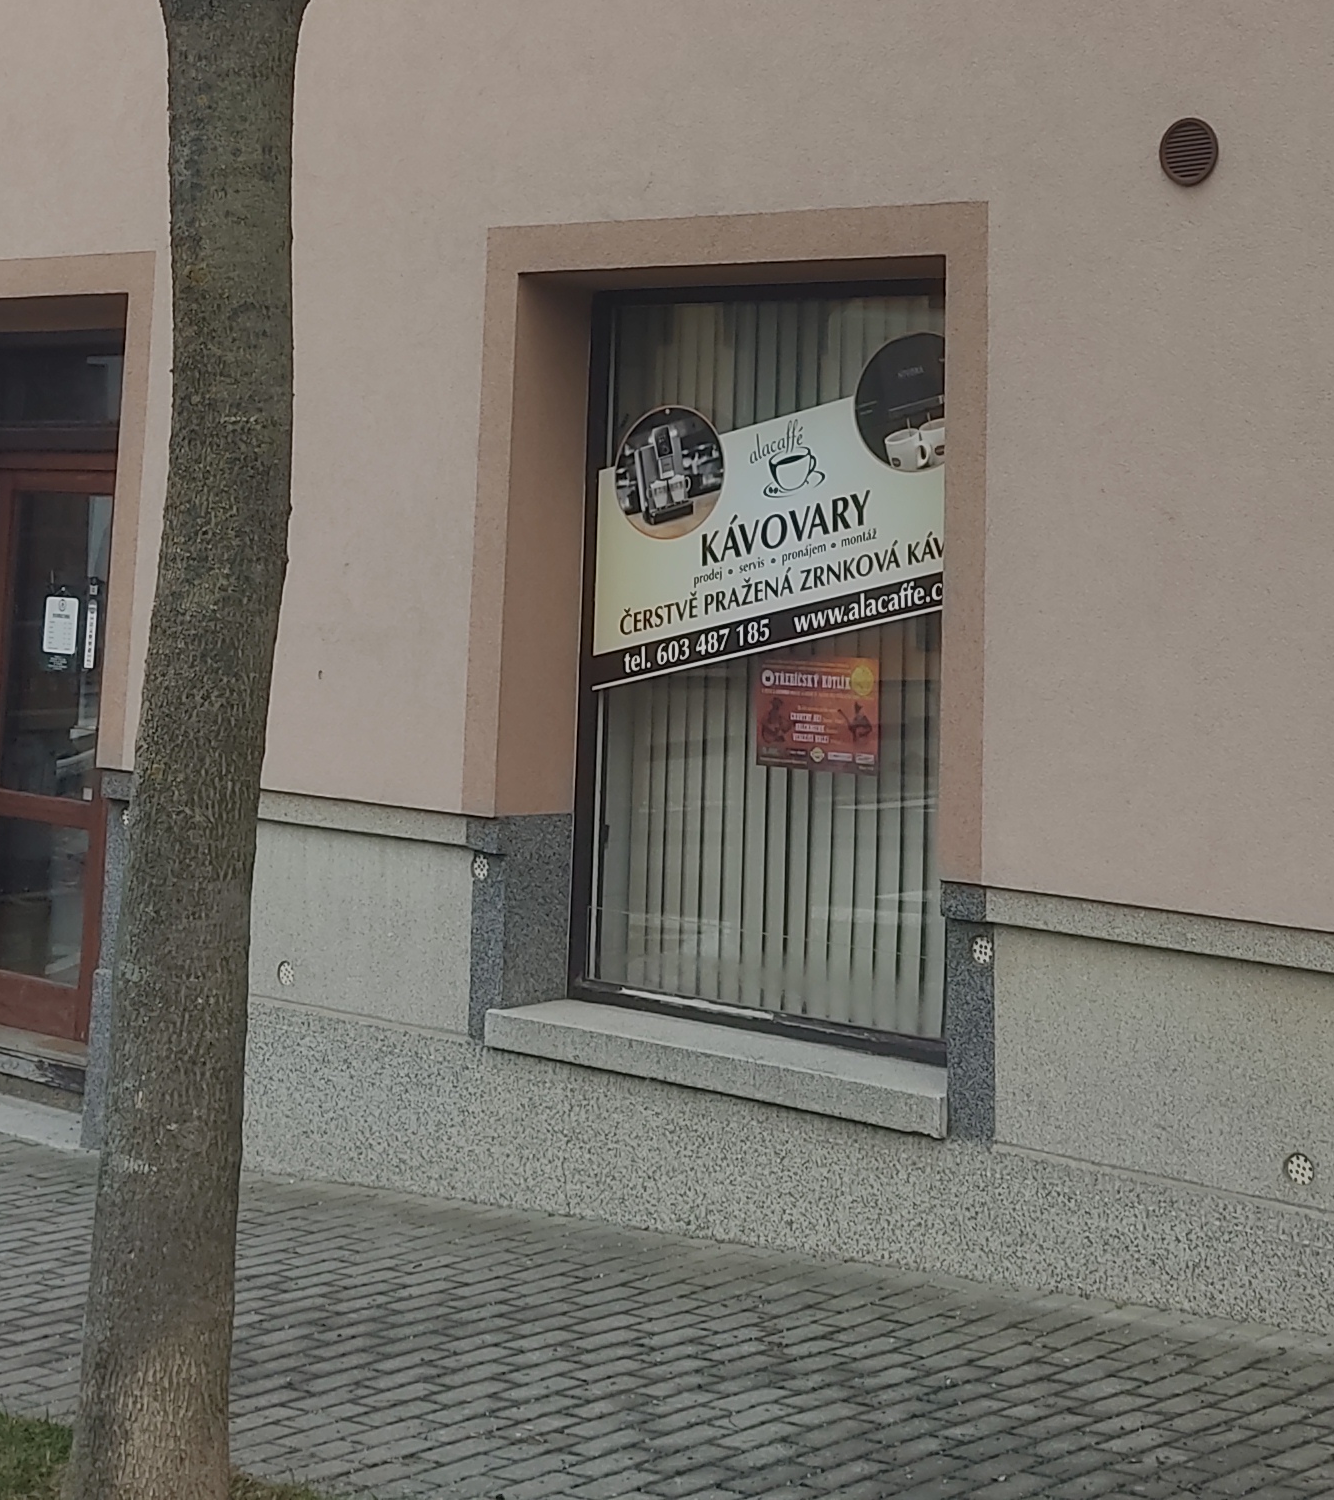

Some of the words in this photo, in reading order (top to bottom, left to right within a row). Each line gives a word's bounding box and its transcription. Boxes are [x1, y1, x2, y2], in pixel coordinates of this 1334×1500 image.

[749, 419, 804, 464] alacaffé
[693, 567, 723, 589] prodej
[739, 556, 765, 574] servis
[782, 541, 827, 566] pronájem
[841, 528, 878, 548] montáž
[701, 490, 871, 566] KÁVOVARY
[620, 591, 698, 635] ČERSTVĚ
[704, 567, 794, 616] PRAŽENÁ
[799, 539, 901, 592] ZRNKOVÁ
[624, 645, 652, 673] tel.
[656, 638, 690, 665] 603
[695, 627, 730, 655] 487
[736, 618, 770, 647] 185
